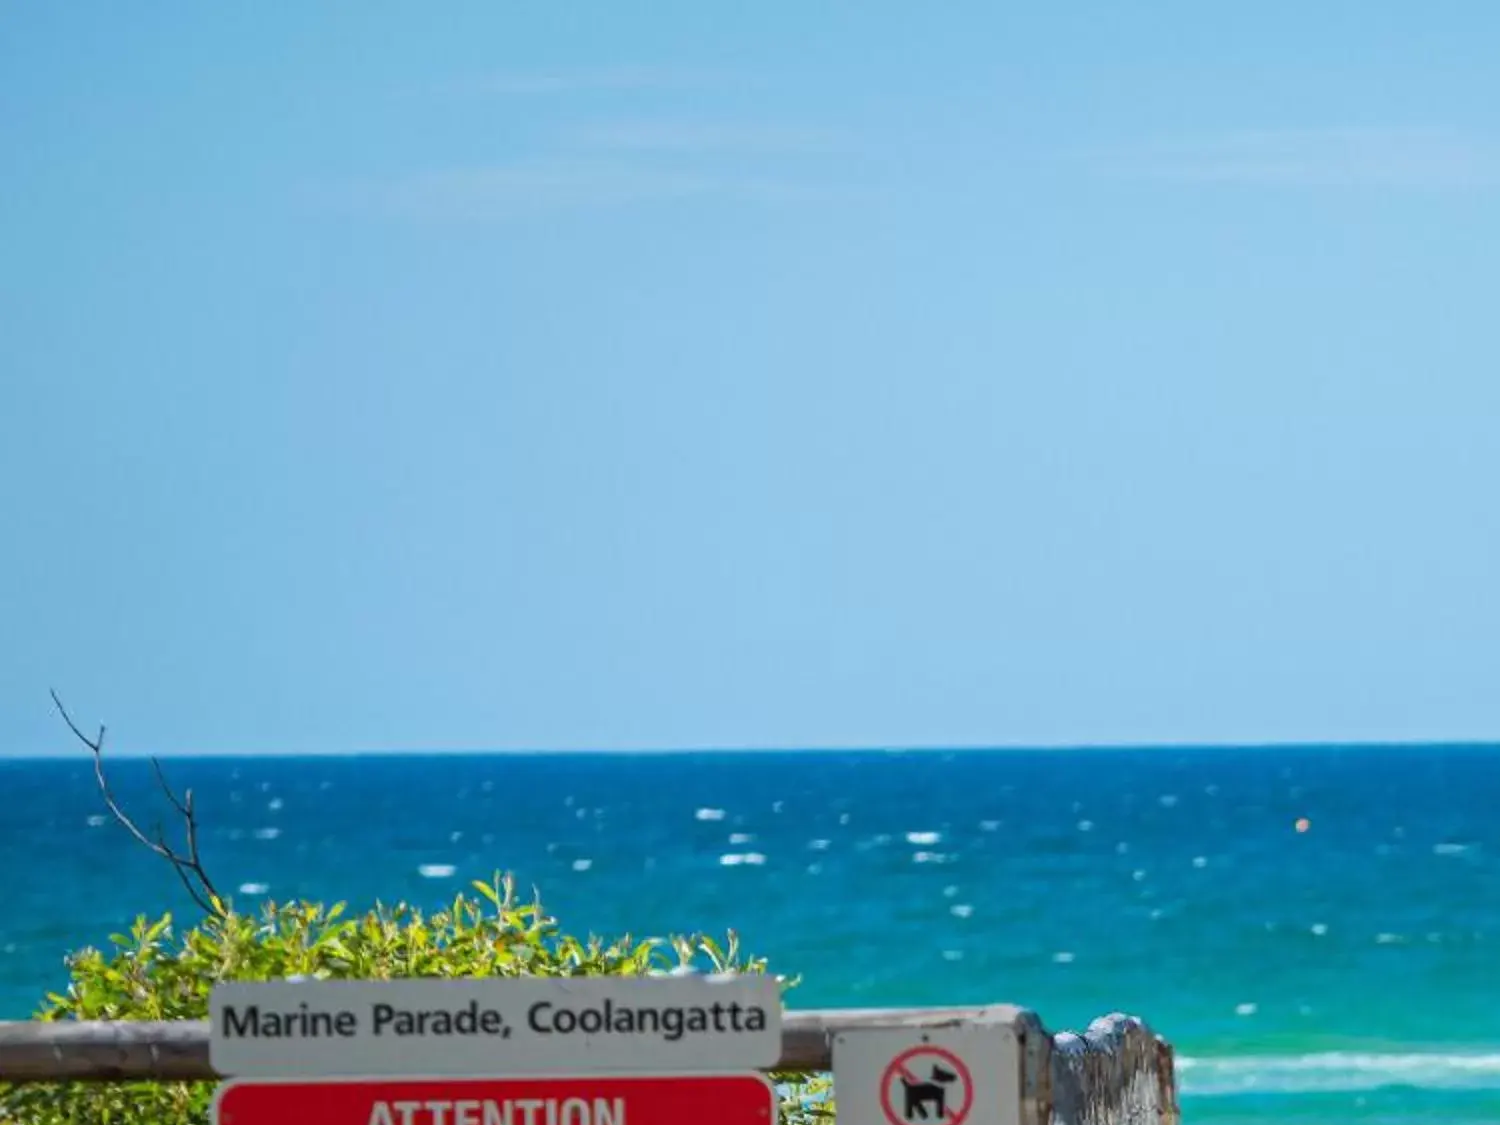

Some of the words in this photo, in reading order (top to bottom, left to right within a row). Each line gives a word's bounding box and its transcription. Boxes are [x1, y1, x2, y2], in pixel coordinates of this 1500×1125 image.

[222, 1003, 357, 1038] Marine
[372, 1003, 513, 1040] Parade,
[527, 999, 767, 1040] Coolangatta
